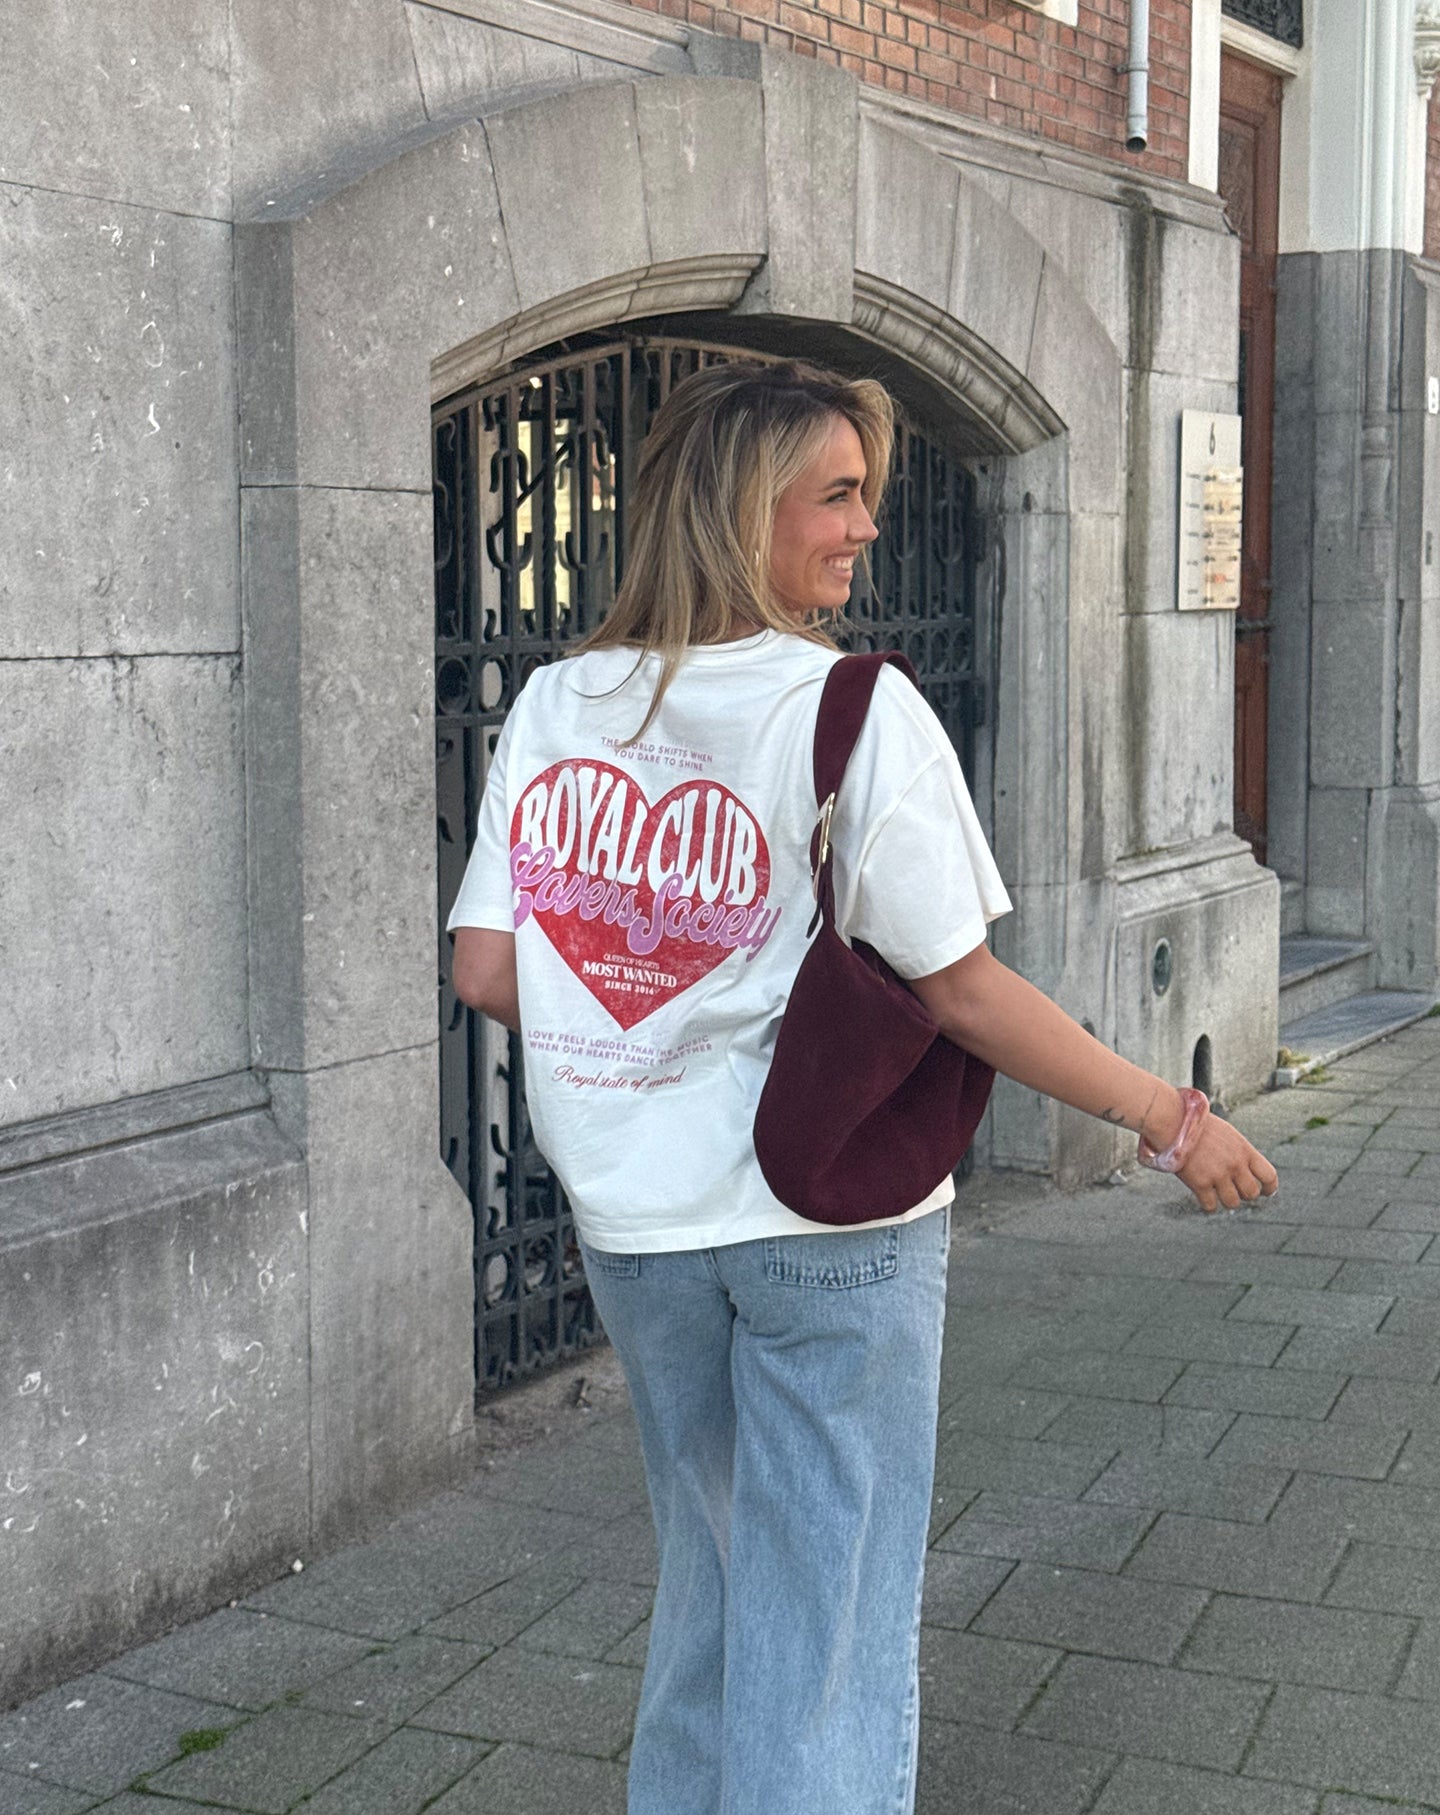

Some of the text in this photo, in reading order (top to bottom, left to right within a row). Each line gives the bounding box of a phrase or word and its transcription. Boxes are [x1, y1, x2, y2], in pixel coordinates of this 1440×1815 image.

[601, 736, 712, 762] THE ORLD SHIFTS WHEN
[614, 749, 634, 759] YOU
[637, 754, 660, 763] DARE
[679, 761, 703, 771] SHINE
[521, 767, 758, 906] ROYAL CLUB
[510, 842, 782, 963] Lovers Society
[582, 961, 677, 988] MOST WANTED
[603, 953, 660, 970] QUEEN OF HEARTS
[605, 981, 654, 995] SINCE 2014
[528, 1030, 553, 1041] LOVE
[558, 1034, 586, 1045] FEELS
[590, 1038, 627, 1051] LOUDER
[630, 1044, 654, 1056] THAN
[677, 1035, 709, 1052] MUSIC
[529, 1041, 559, 1052] WHEN
[563, 1045, 583, 1055] OUR
[586, 1049, 622, 1062] HEARTS
[624, 1054, 655, 1066] DANCE
[552, 1064, 687, 1092] Royal state of mind
